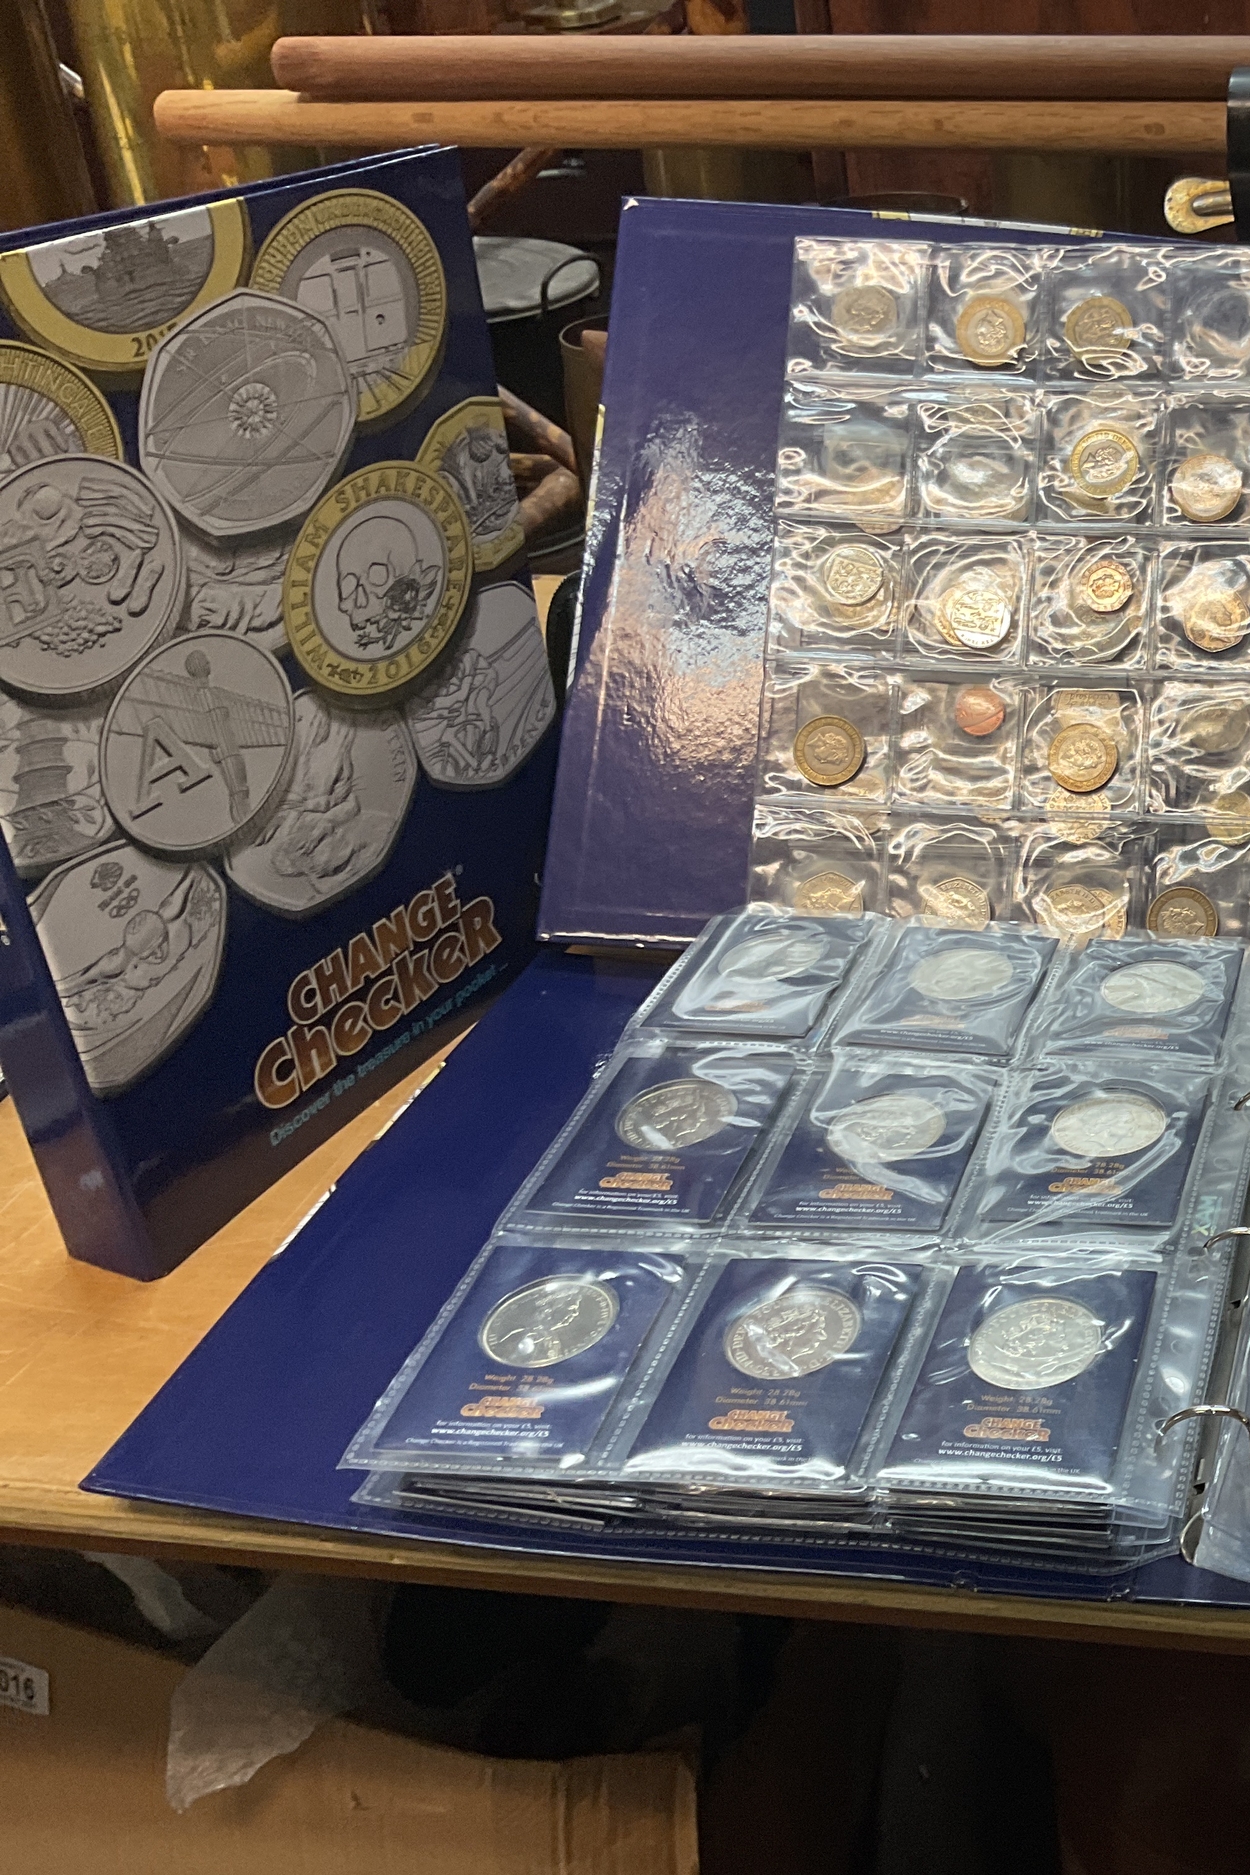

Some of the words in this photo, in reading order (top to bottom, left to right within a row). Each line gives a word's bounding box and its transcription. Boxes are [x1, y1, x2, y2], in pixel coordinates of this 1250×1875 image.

[291, 519, 331, 671] WILLIAM
[334, 469, 467, 593] SHAKESPEARE
[288, 872, 461, 1025] CHANGE
[269, 1091, 331, 1146] Discover
[331, 1073, 357, 1097] the
[357, 1028, 412, 1078] treasure
[412, 1020, 427, 1036] in
[426, 998, 453, 1031] your
[981, 1416, 1042, 1429] CHANGE
[431, 1428, 549, 1438] www.changechecker.org/£5
[681, 1441, 803, 1452] www.changechecker.org/£5
[938, 1448, 1063, 1462] www.changechecker.org/£5
